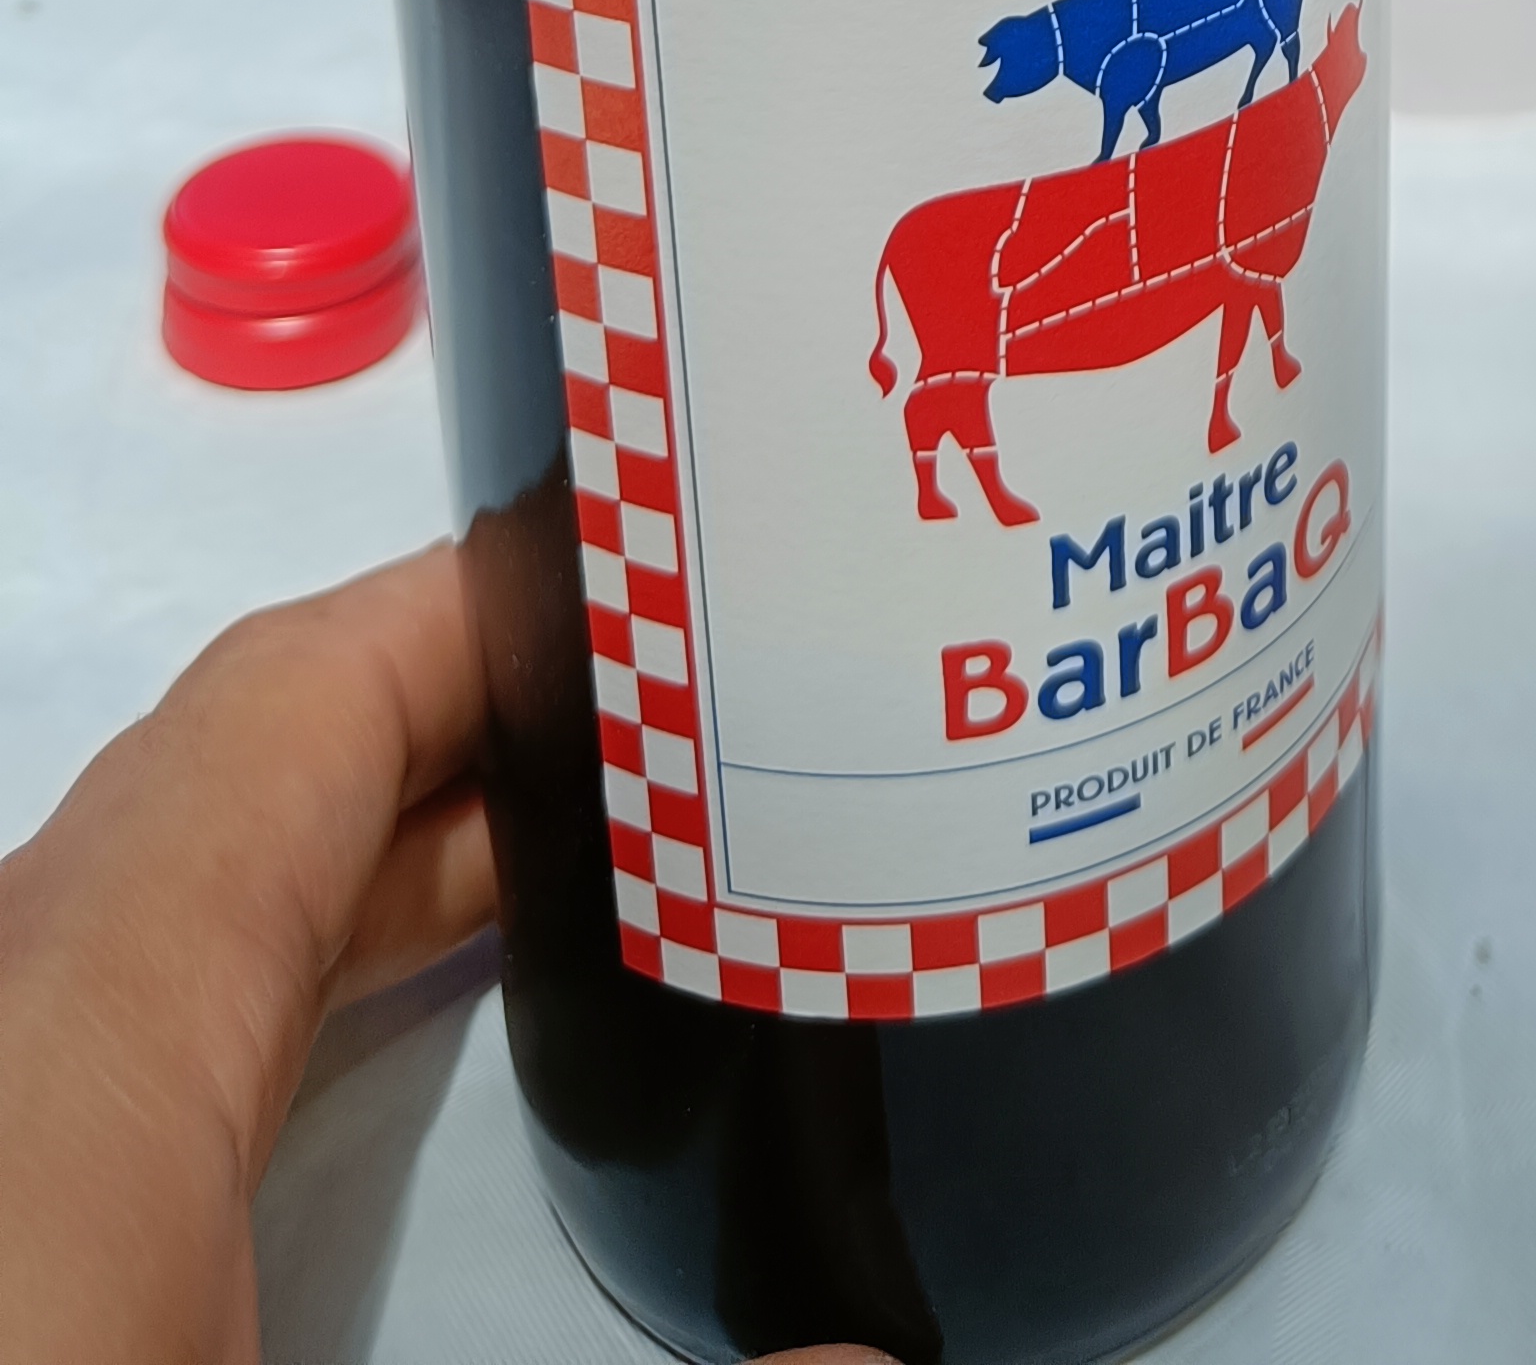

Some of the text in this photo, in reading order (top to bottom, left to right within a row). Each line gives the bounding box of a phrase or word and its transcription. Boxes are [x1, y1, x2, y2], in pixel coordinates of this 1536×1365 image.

[941, 458, 1351, 741] BarBaQ
[1050, 441, 1298, 609] Maitre
[1030, 639, 1315, 816] PRODUIT DE FRANCE
